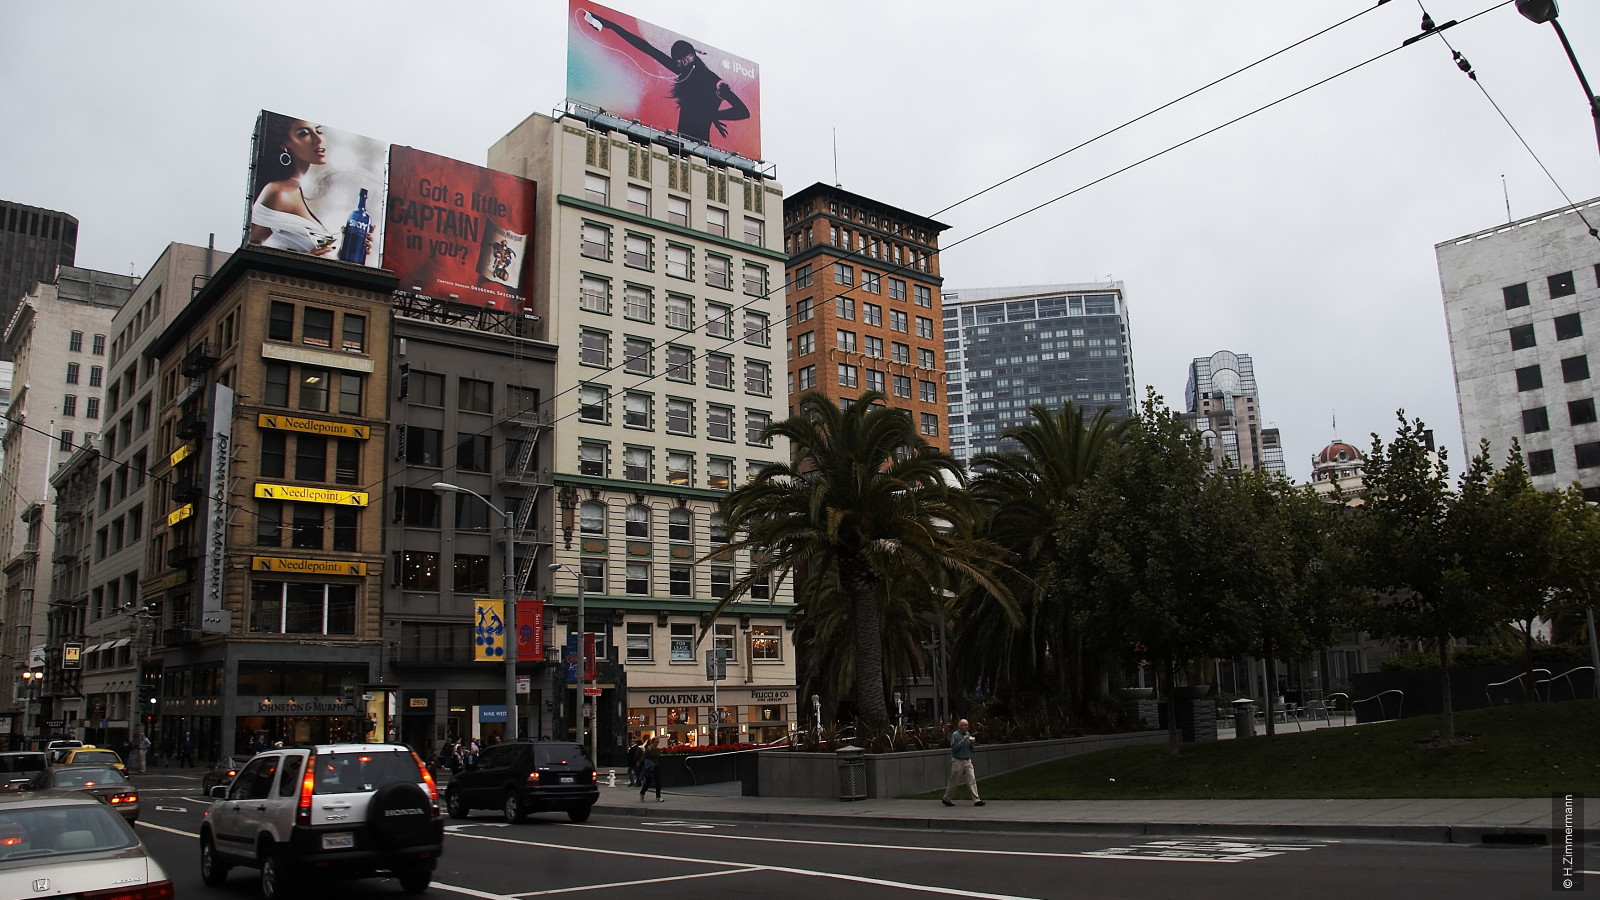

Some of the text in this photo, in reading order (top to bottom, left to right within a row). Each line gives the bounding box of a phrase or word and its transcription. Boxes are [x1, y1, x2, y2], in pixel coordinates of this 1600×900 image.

[732, 62, 755, 79] iPod
[419, 178, 507, 218] Got a little
[389, 197, 479, 243] CAPTAIN
[406, 229, 469, 265] in you?
[266, 344, 296, 359] World
[348, 359, 370, 369] Club
[284, 418, 344, 434] Needlepoint
[280, 487, 339, 501] Needlepoint
[209, 431, 229, 600] JOHNSTON & MURPHY
[278, 559, 338, 572] Needlepoint
[648, 695, 678, 704] GIOIA
[677, 694, 699, 704] FINE
[751, 690, 774, 698] FELICCI
[258, 702, 348, 713] JOHNSTON & MURPHY
[384, 808, 425, 816] HONDA
